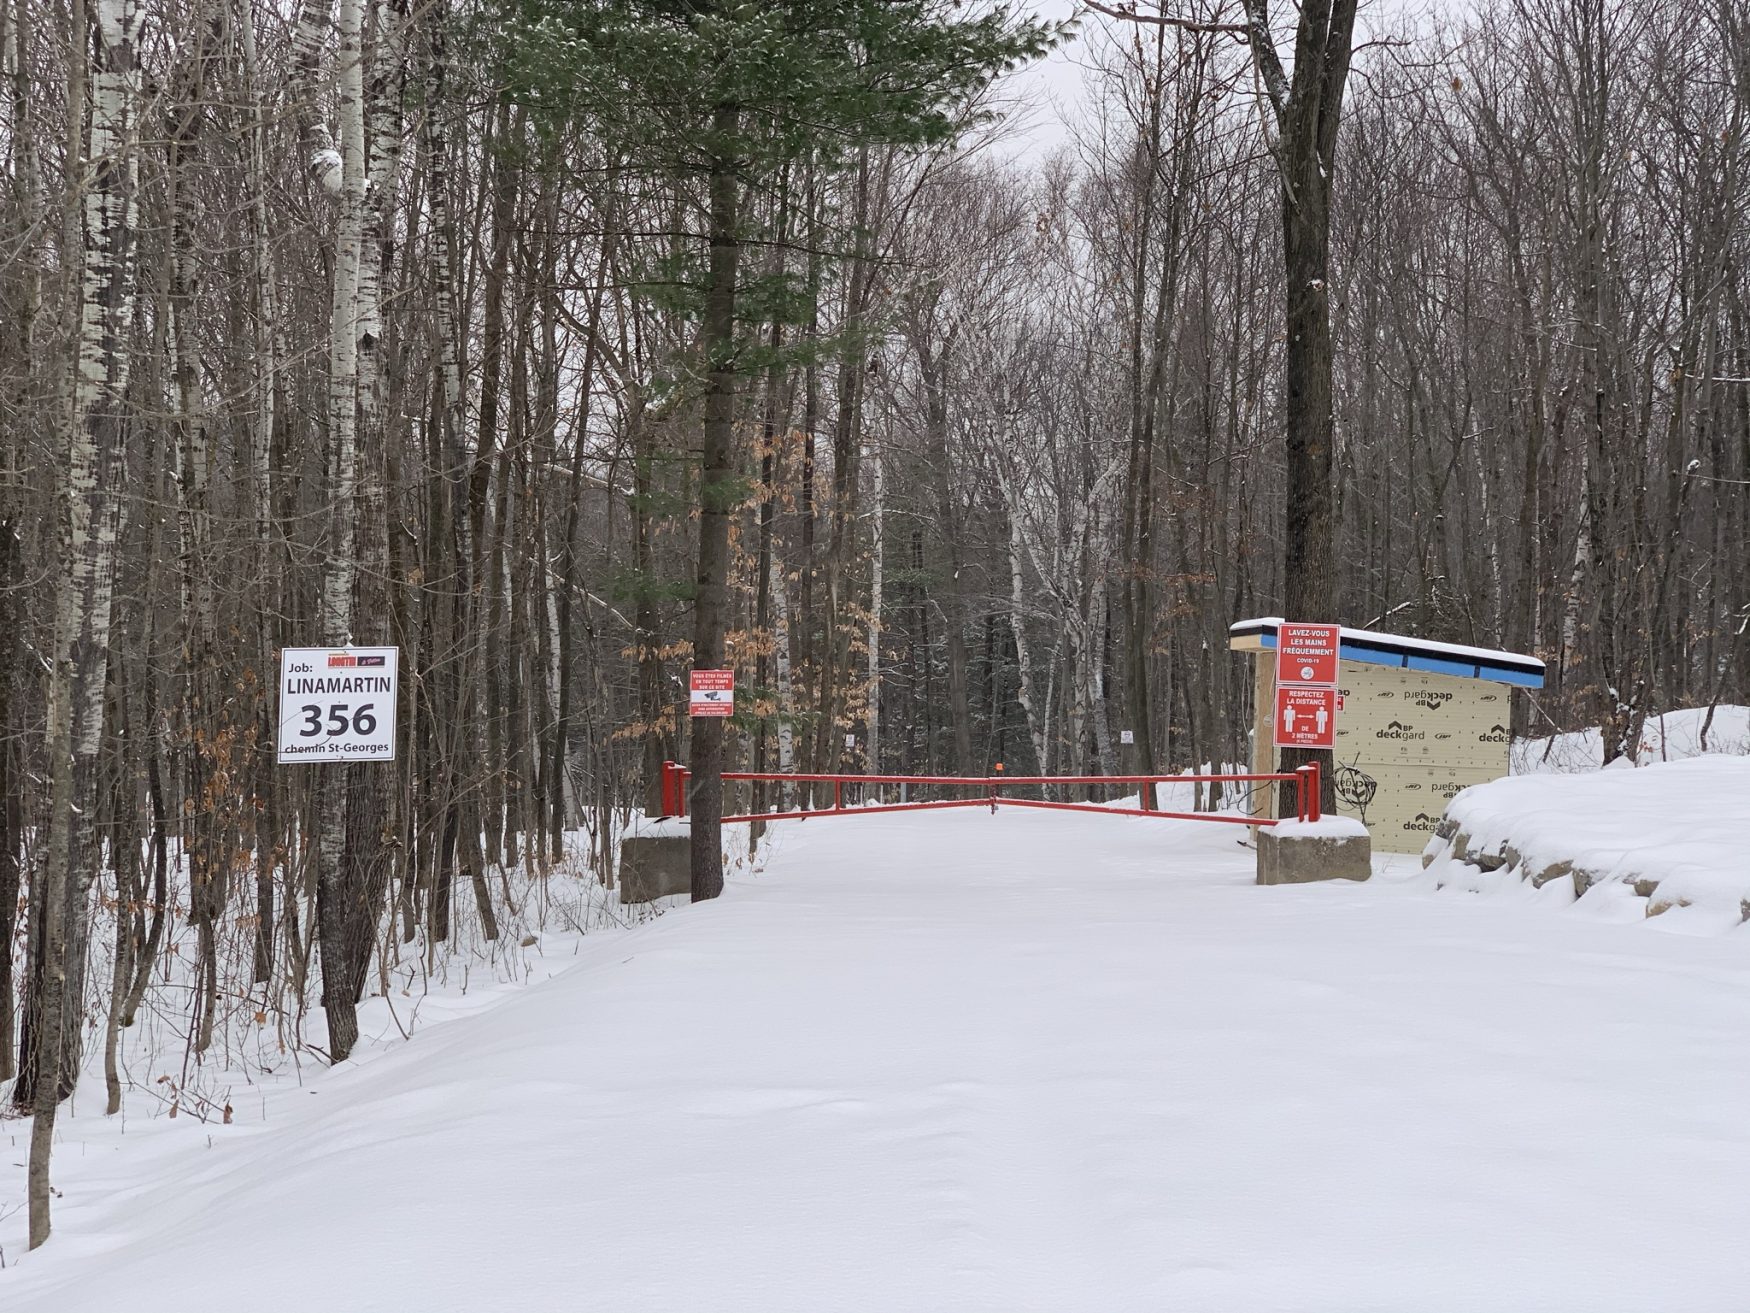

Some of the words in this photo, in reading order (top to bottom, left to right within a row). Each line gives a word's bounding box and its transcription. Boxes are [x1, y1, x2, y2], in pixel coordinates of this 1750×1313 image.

[1288, 629, 1330, 637] LAVEZ-VOUS
[1283, 646, 1334, 656] FRÉQUEMMENT
[289, 663, 313, 673] Job:
[287, 677, 391, 694] LINAMARTIN
[1289, 690, 1324, 698] RESPECTEZ
[1404, 690, 1453, 702] deckgard
[1296, 698, 1326, 706] DISTANCE
[299, 703, 377, 737] 356
[1376, 729, 1425, 741] deckgard
[284, 744, 326, 754] chemin
[328, 743, 389, 754] St-Georges
